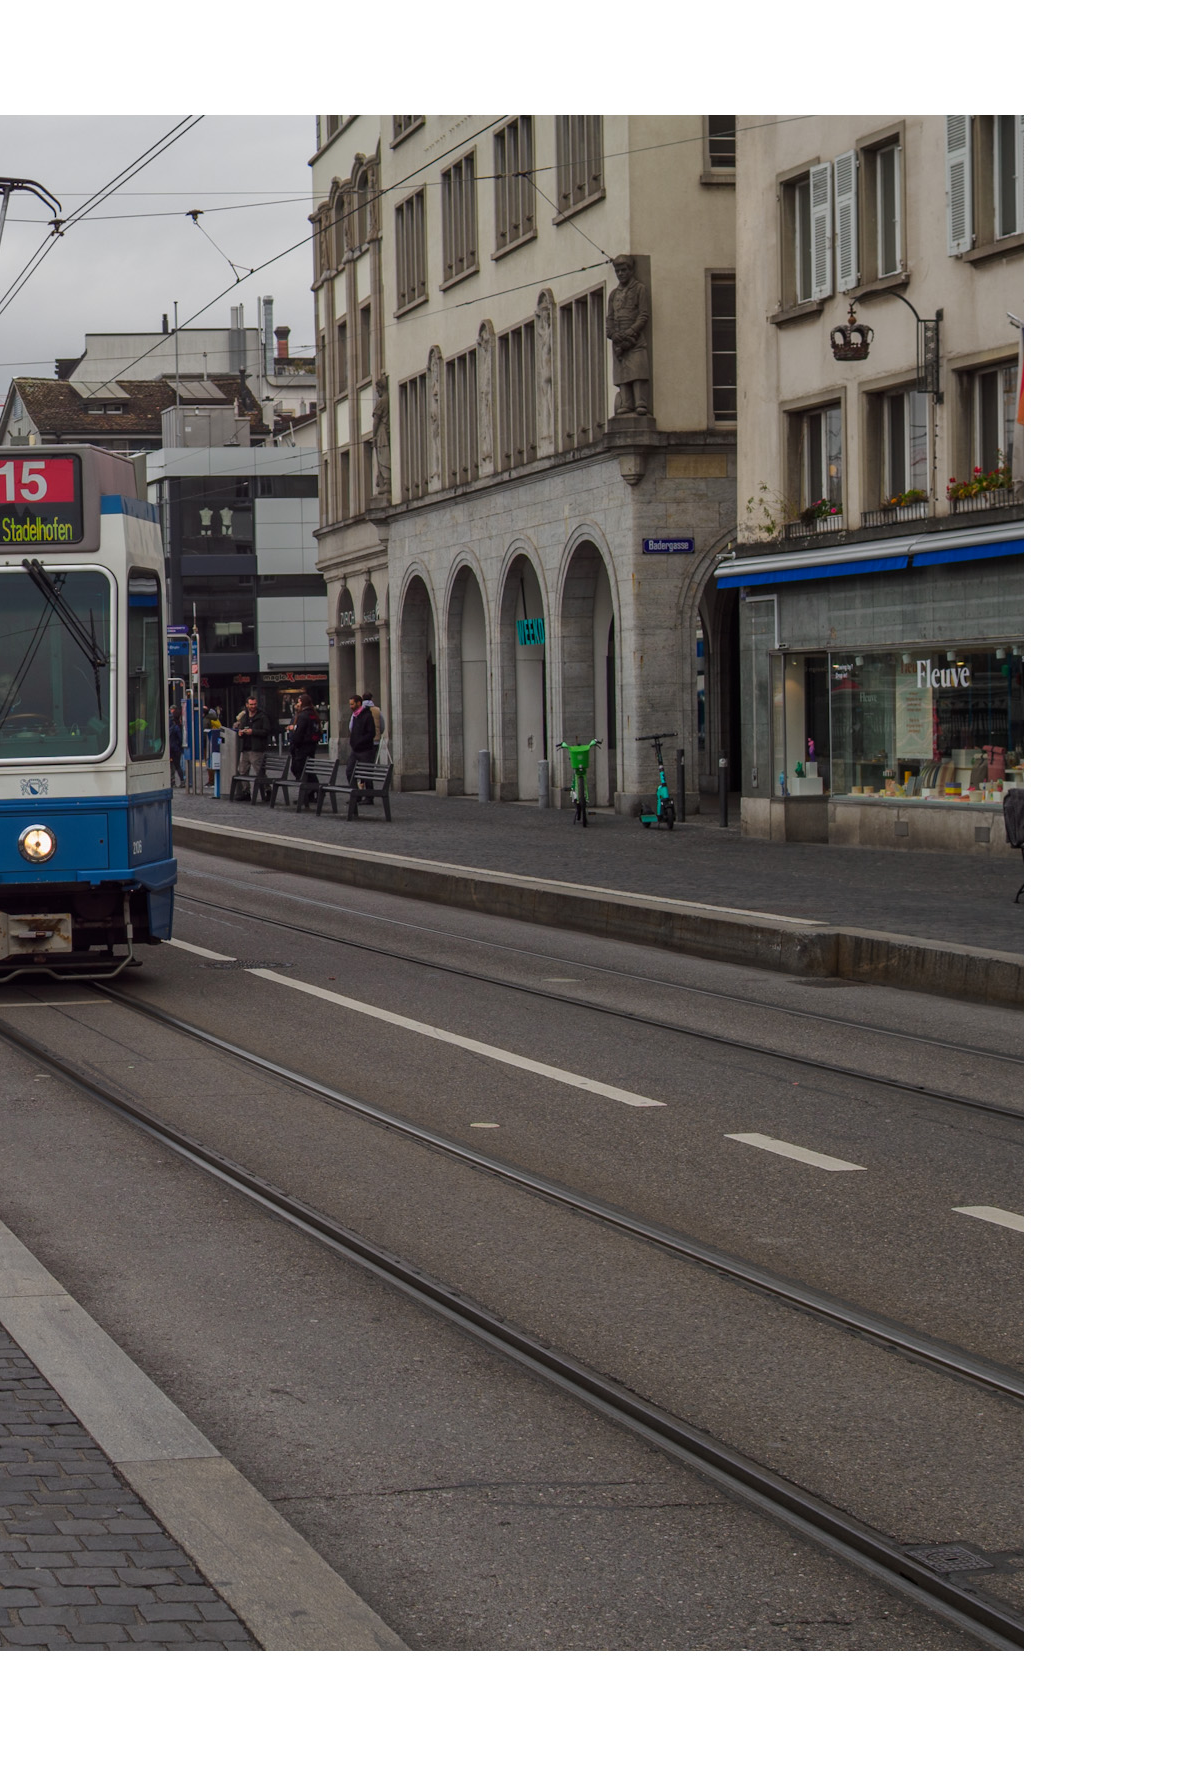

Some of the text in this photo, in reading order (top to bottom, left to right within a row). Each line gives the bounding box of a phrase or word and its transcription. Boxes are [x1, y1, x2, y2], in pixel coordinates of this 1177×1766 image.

[2, 516, 73, 542] Stadelhofen
[648, 540, 689, 552] Badergasse
[916, 659, 970, 688] Fleuve
